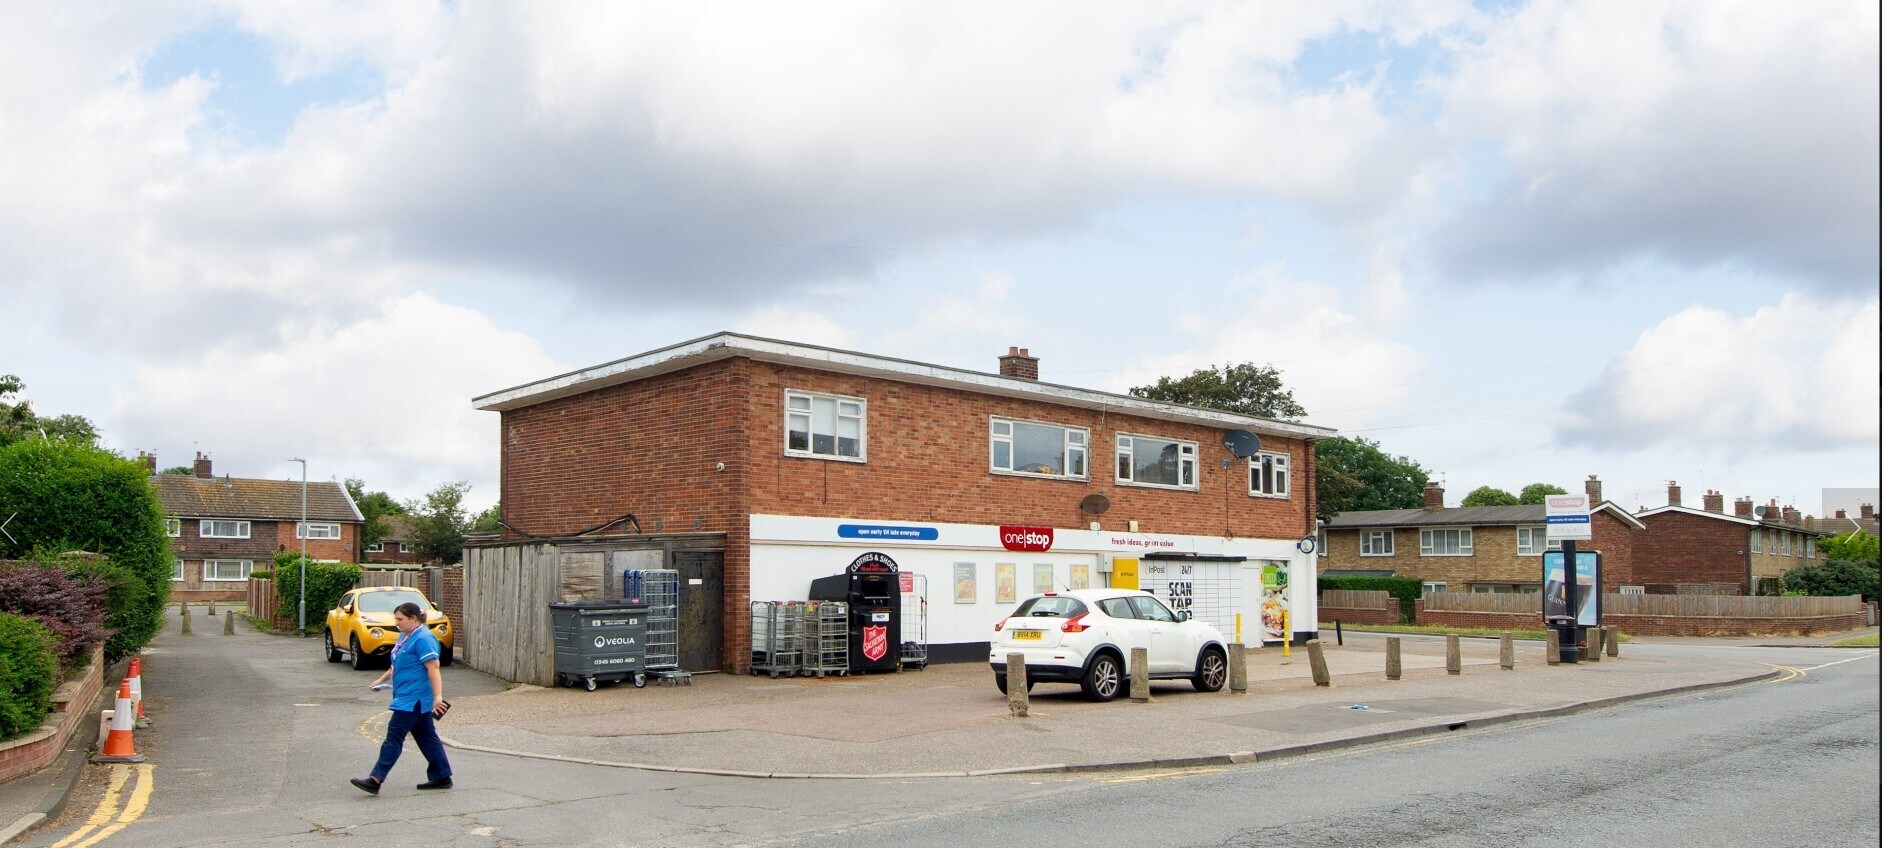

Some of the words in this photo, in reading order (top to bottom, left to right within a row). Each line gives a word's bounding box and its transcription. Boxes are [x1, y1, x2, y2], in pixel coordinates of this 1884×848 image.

[1127, 539, 1143, 547] ideas,
[851, 554, 874, 572] CLOTHES
[880, 556, 898, 573] SHOES
[1149, 565, 1166, 574] InPost
[1182, 565, 1192, 575] 24/7
[1169, 582, 1192, 596] SCAN
[1169, 597, 1192, 609] TAP
[868, 629, 877, 640] THE
[606, 637, 635, 645] VEOLIA
[864, 631, 885, 652] SALVATION
[872, 641, 885, 656] ARMY
